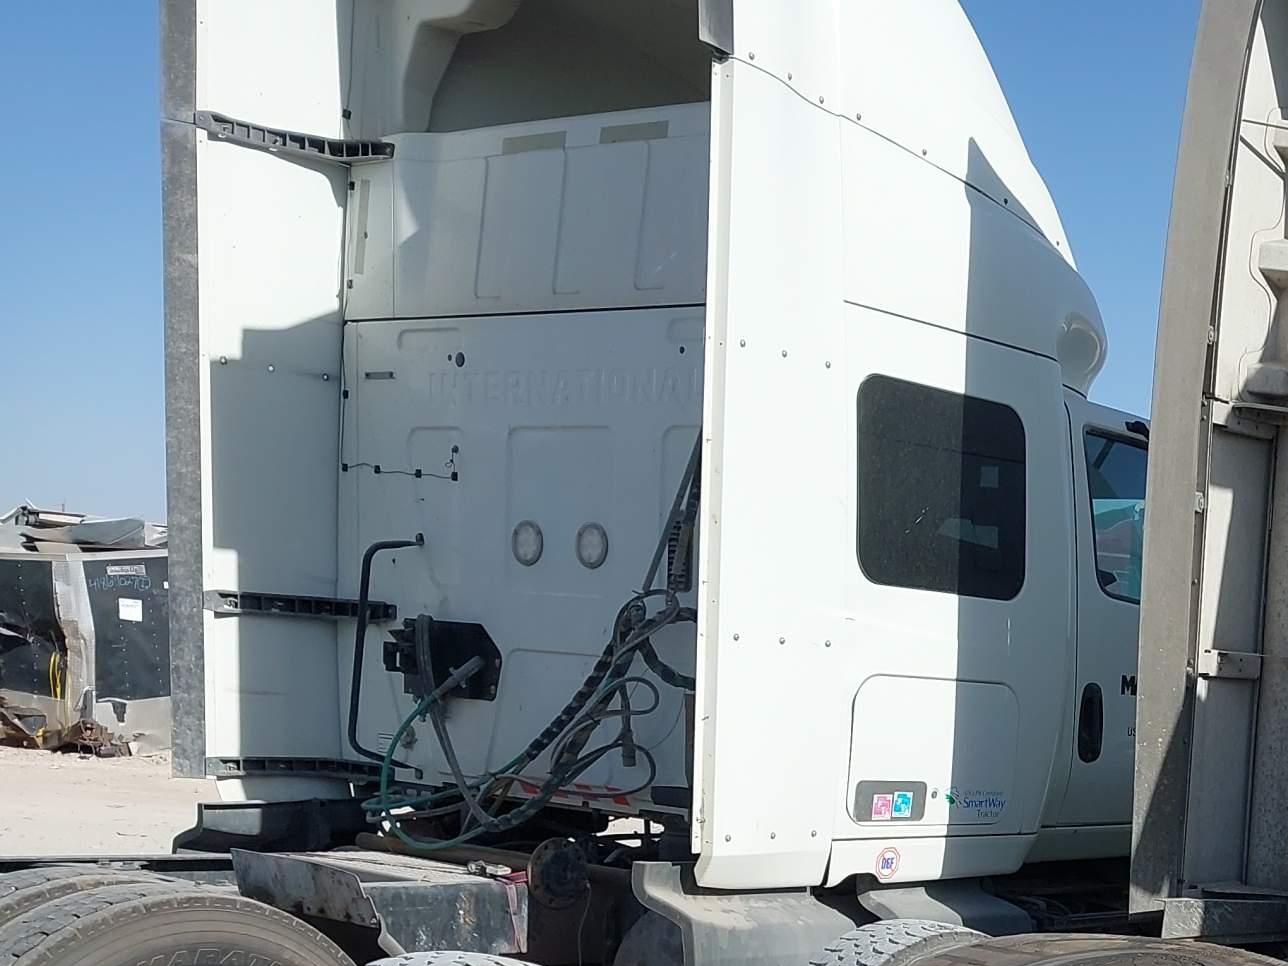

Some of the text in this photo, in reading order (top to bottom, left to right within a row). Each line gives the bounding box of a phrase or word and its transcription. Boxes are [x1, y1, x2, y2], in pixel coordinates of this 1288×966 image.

[962, 797, 1006, 811] SmartWay
[976, 809, 1000, 818] Tractor
[881, 857, 895, 870] DEF
